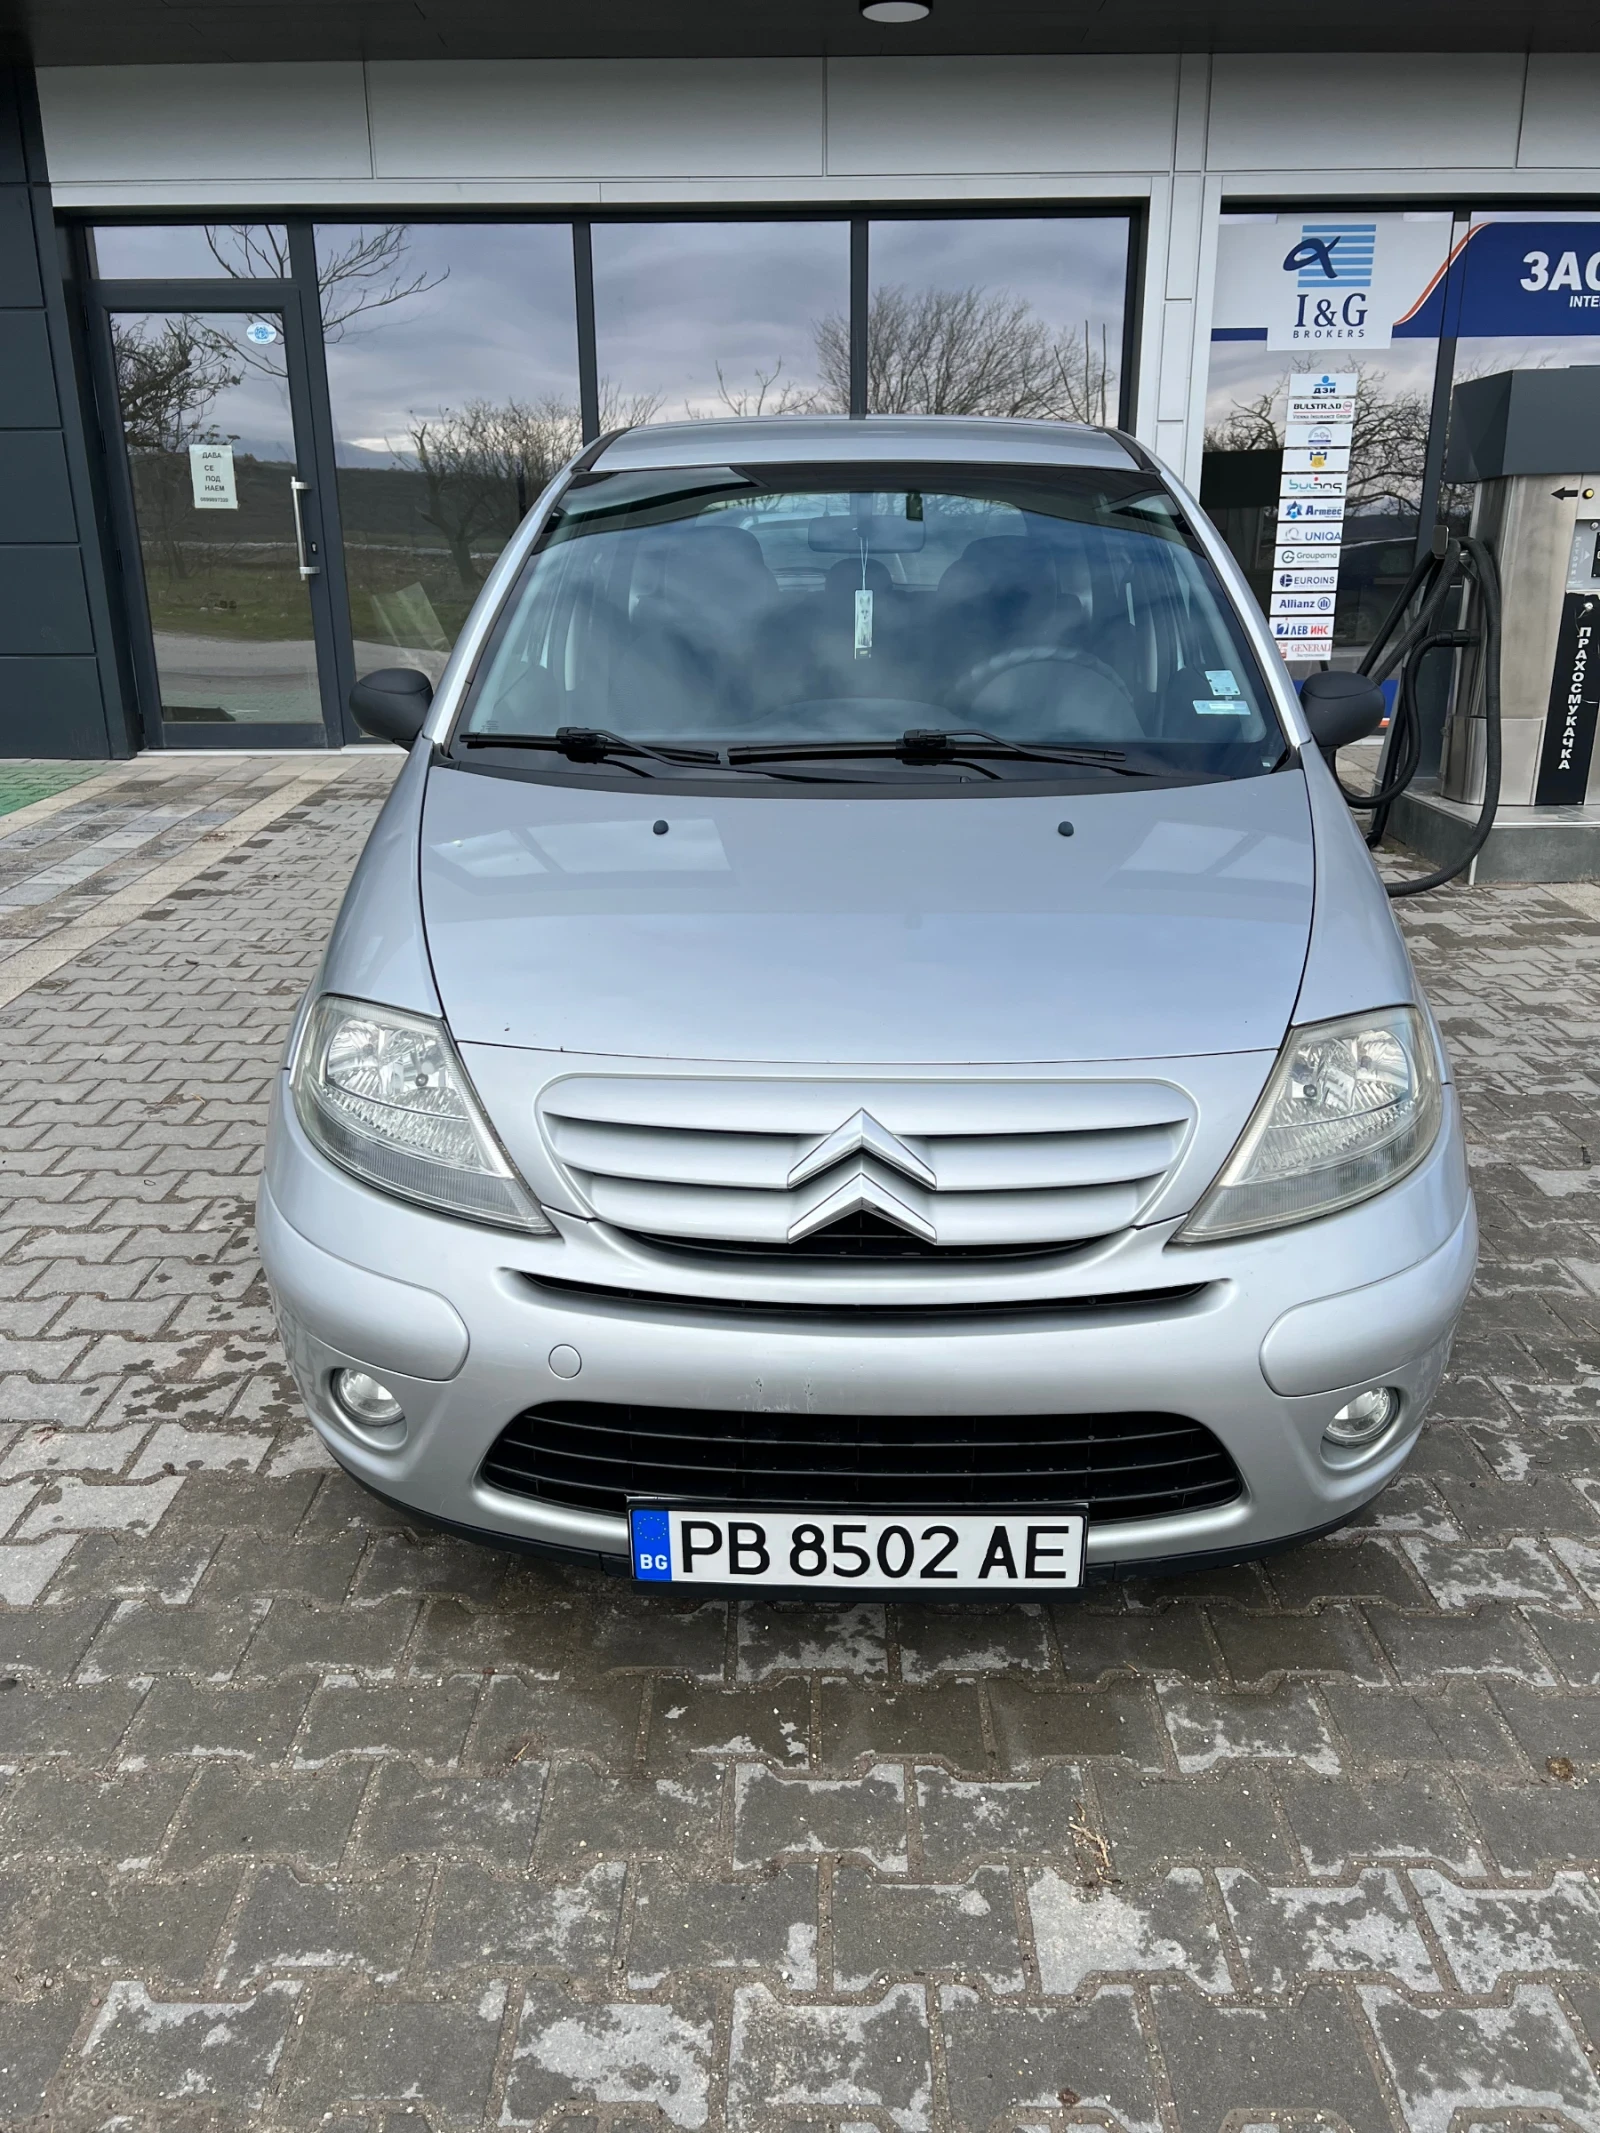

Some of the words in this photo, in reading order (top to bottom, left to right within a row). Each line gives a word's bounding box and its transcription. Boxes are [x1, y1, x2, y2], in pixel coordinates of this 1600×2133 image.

[1569, 295, 1600, 308] INTE
[1293, 329, 1365, 338] BROKERS
[202, 451, 222, 459] ДАВА
[205, 475, 221, 483] ПОД
[1305, 505, 1342, 515] Armeec
[1305, 531, 1341, 541] UNIQA
[1296, 552, 1337, 560] Groupama
[1294, 576, 1335, 584] EUROINS
[1279, 599, 1315, 608] Allianz
[1291, 625, 1308, 635] ЛЕВ
[1310, 625, 1329, 635] ИНС
[1558, 626, 1592, 770] ПРАХОСМУКАЧКА
[640, 1553, 668, 1570] BG
[681, 1520, 770, 1576] PB
[789, 1523, 959, 1579] 8502
[977, 1525, 1069, 1579] AE
